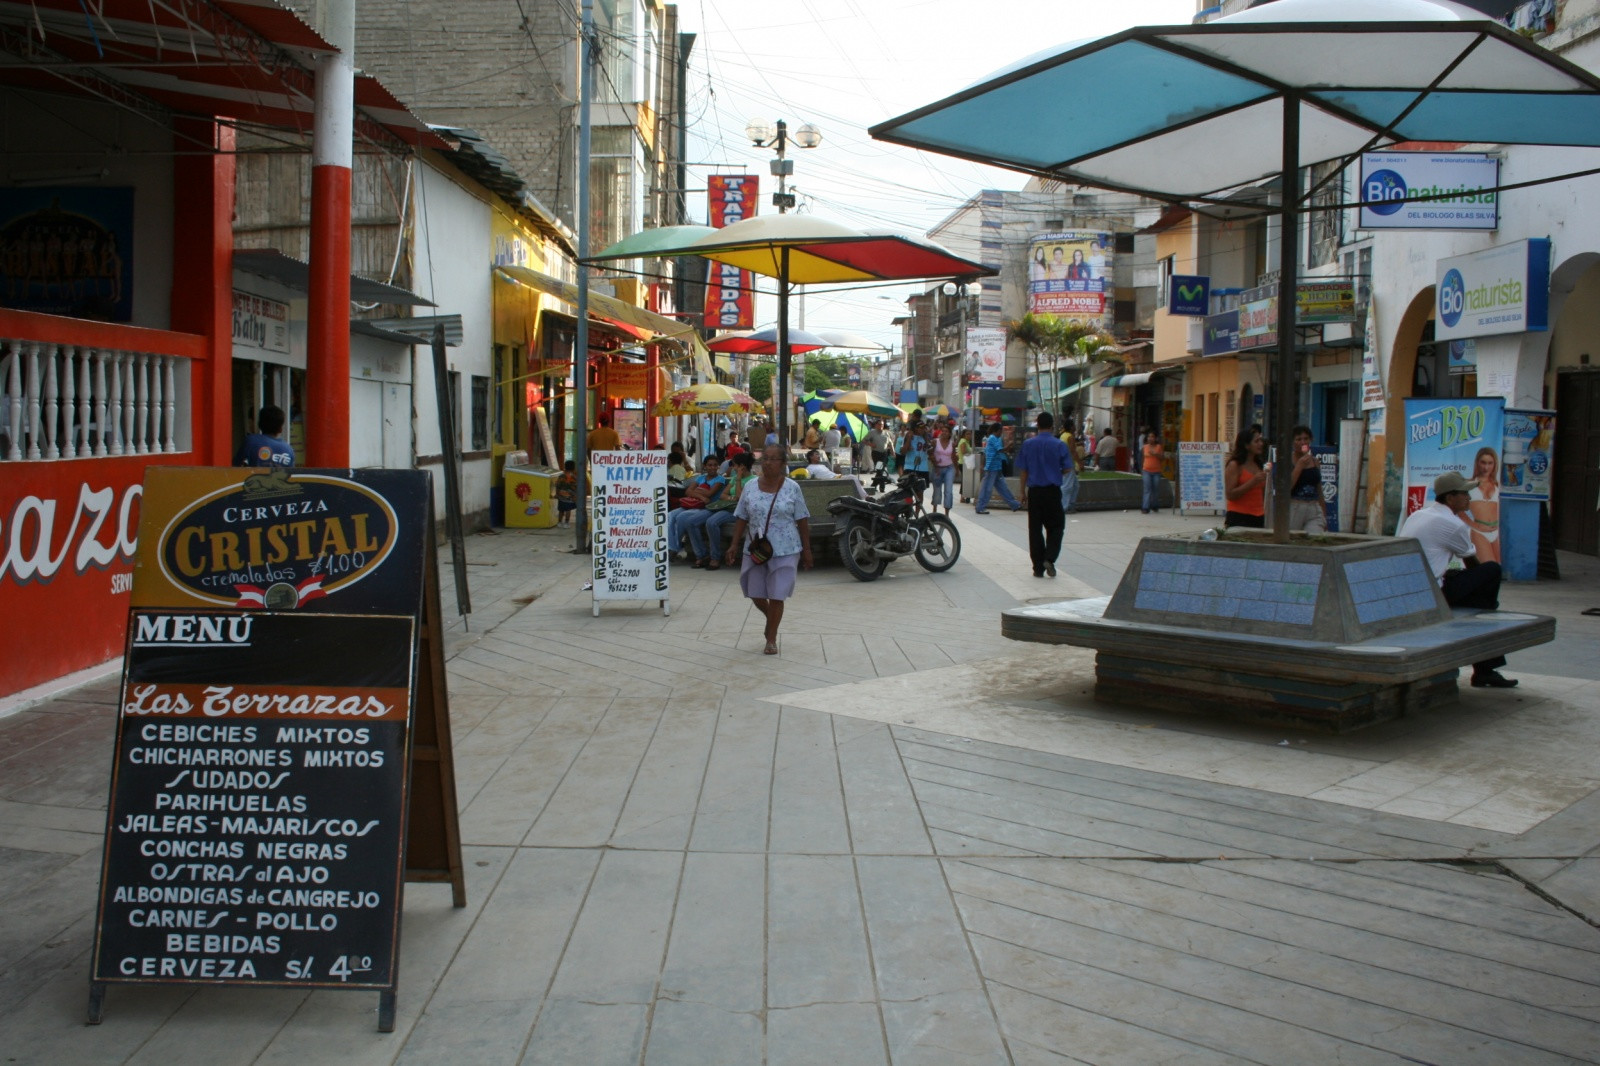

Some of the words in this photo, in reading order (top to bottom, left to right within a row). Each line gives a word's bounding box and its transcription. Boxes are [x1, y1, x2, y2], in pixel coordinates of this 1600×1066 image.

[720, 178, 744, 326] TRAGNEDAS
[1037, 298, 1070, 306] ALFRED
[1072, 298, 1101, 306] NOBEL
[1441, 286, 1463, 315] Bio
[1465, 278, 1522, 311] naturista
[1410, 418, 1440, 443] Reto
[1439, 405, 1485, 450] Bio
[593, 452, 622, 465] Centro
[623, 453, 634, 465] de
[636, 453, 666, 465] Belleza
[1533, 463, 1546, 472] 35
[607, 495, 652, 504] Ondulaciones
[613, 483, 641, 495] Tintes
[223, 500, 329, 523] CERVEZA
[609, 507, 645, 517] Limpieza
[609, 517, 618, 526] de
[620, 516, 643, 525] Cutis
[594, 485, 606, 580] MANICURE
[610, 526, 652, 537] Mascarillas
[653, 487, 667, 591] PEDICURE
[175, 513, 378, 577] CRISTAL
[616, 538, 648, 549] Belleza
[136, 613, 253, 643] MENÚ
[125, 685, 194, 716] Las
[201, 686, 394, 718] Terrazas
[141, 724, 257, 743] CEBICHES
[276, 727, 370, 744] MIXTOS
[129, 747, 292, 766] CHICHARRONES
[304, 750, 384, 768] MIXTOS
[165, 770, 290, 790] SUDADOS
[155, 794, 307, 813] PARIHUELAS
[140, 840, 244, 859] CONCHAS
[257, 843, 348, 861] NEGRAS
[150, 863, 253, 881] OSTRAS
[255, 865, 271, 882] al
[276, 866, 329, 884] AJO
[113, 886, 243, 905] ALBONDIGAS
[246, 888, 265, 905] de
[267, 890, 380, 909] CANGREJO
[128, 909, 228, 928] CARNES
[256, 913, 338, 931] POLLO
[166, 934, 281, 954] BEBIDAS
[119, 957, 257, 978] CERVEZA
